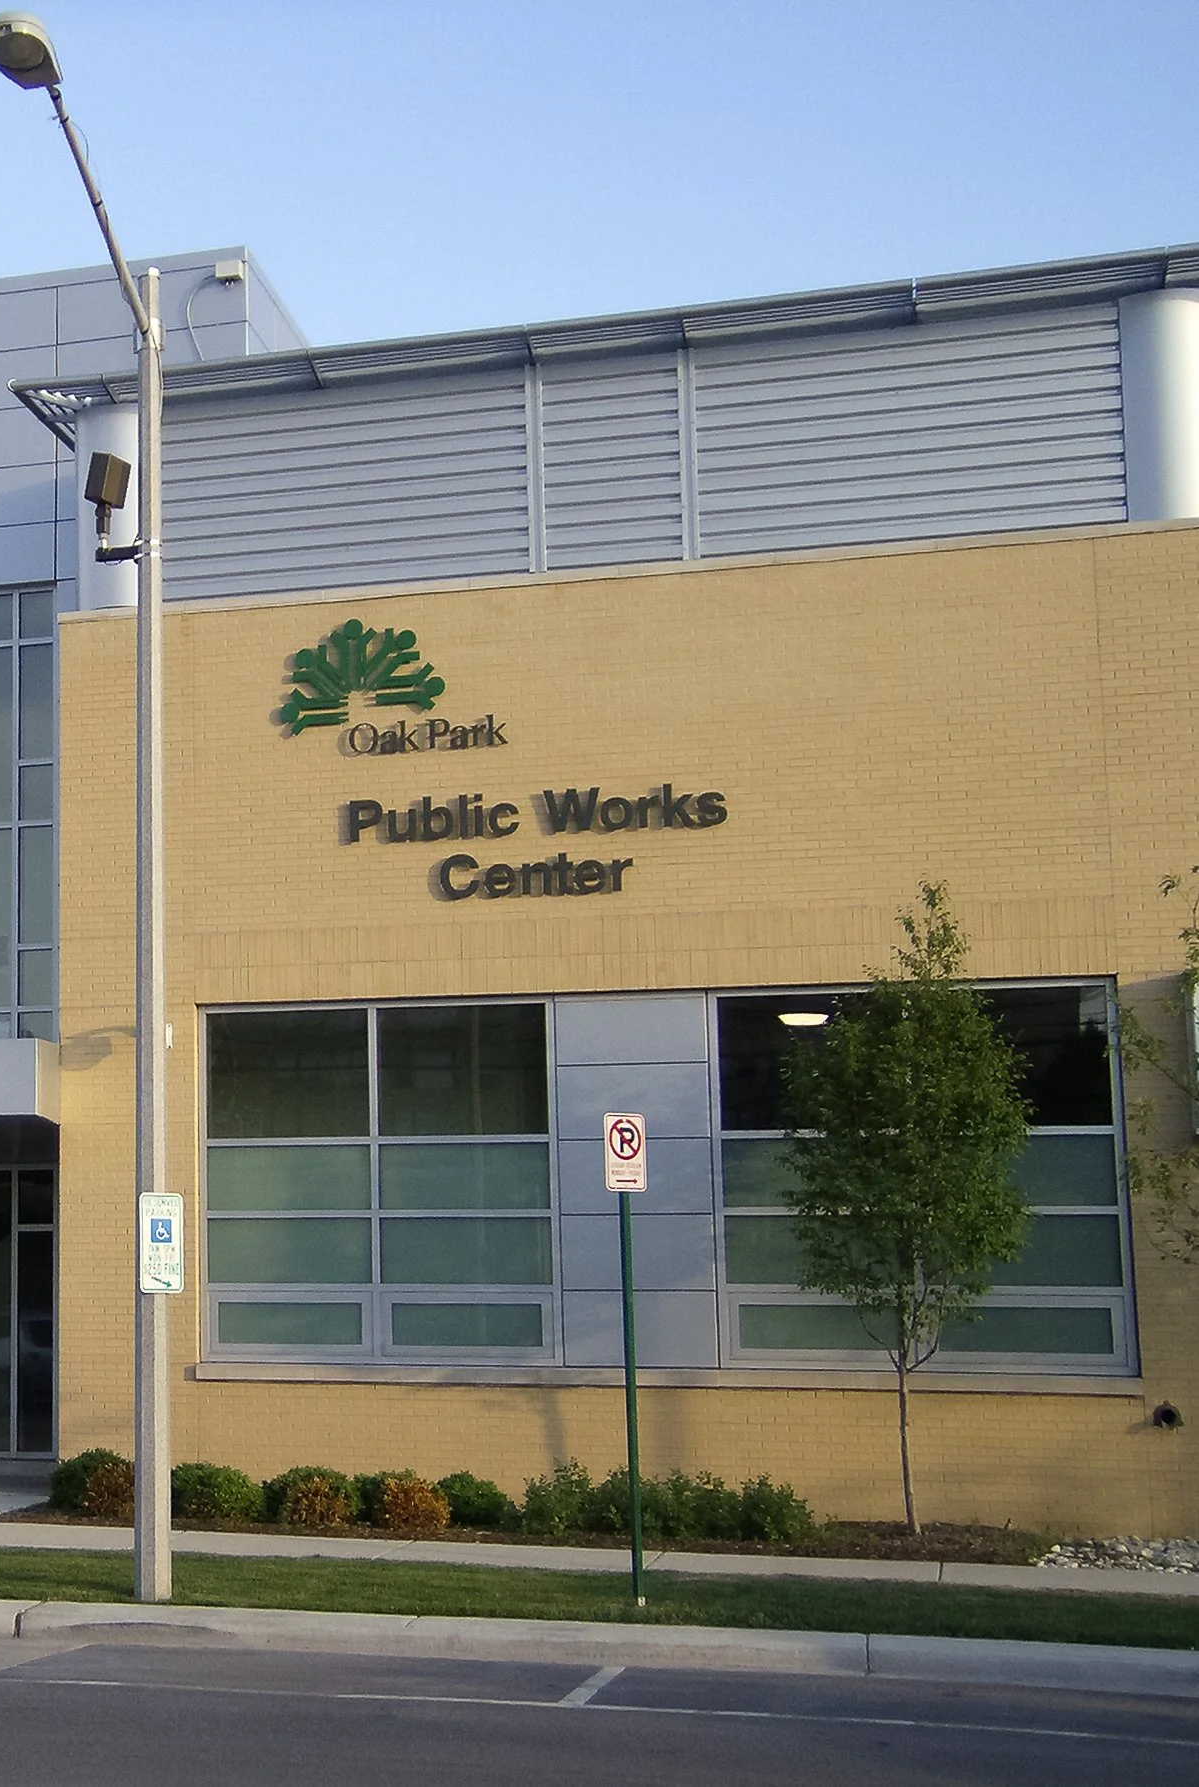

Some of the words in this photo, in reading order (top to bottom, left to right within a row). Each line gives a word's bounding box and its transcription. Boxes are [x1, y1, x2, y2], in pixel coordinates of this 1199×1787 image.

[348, 719, 419, 755] Oak
[425, 713, 508, 751] Park
[349, 793, 520, 843] Public
[543, 783, 728, 833] Works
[439, 851, 634, 900] Center
[145, 1208, 177, 1217] PARKING
